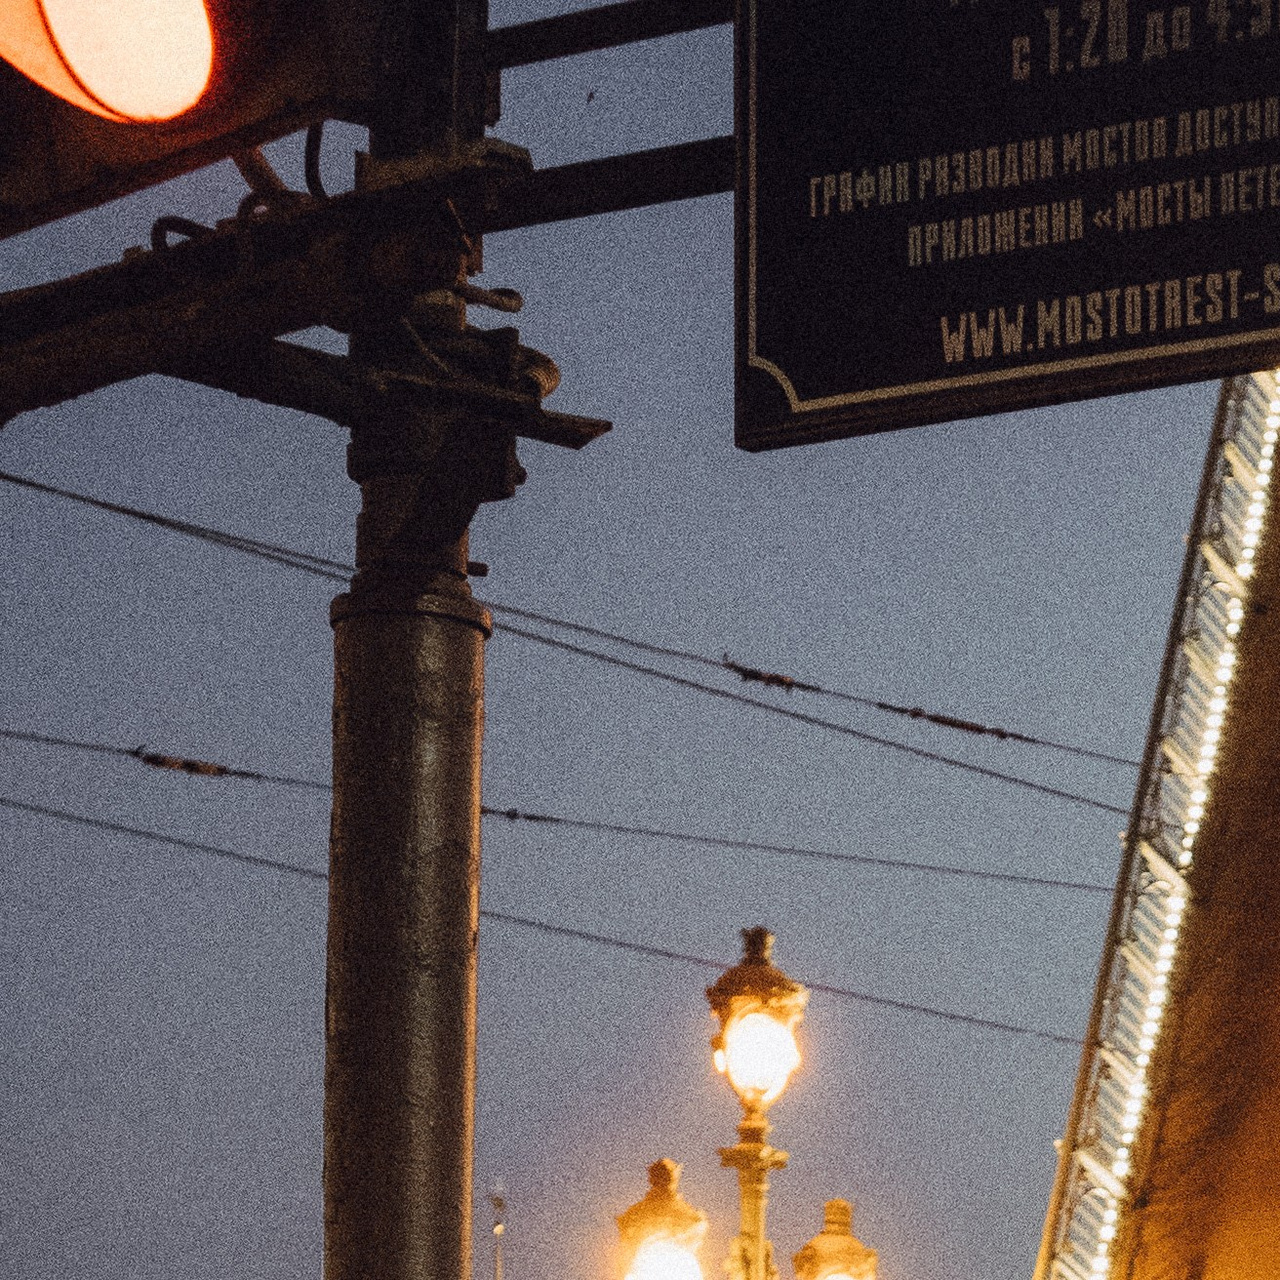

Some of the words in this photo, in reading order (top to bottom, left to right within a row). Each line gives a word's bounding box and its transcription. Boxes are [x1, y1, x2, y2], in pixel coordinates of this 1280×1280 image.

[1012, 35, 1031, 80] с
[1044, 0, 1129, 75] 1:20
[1142, 5, 1192, 63] до
[809, 162, 910, 218] ГРАФИК
[918, 136, 1054, 201] РАЗВОДКИ
[1061, 115, 1168, 175] МОСТОВ
[908, 198, 1084, 267] ПРИЛОЖЕНИИ
[1091, 177, 1211, 233] «МОСТЫ
